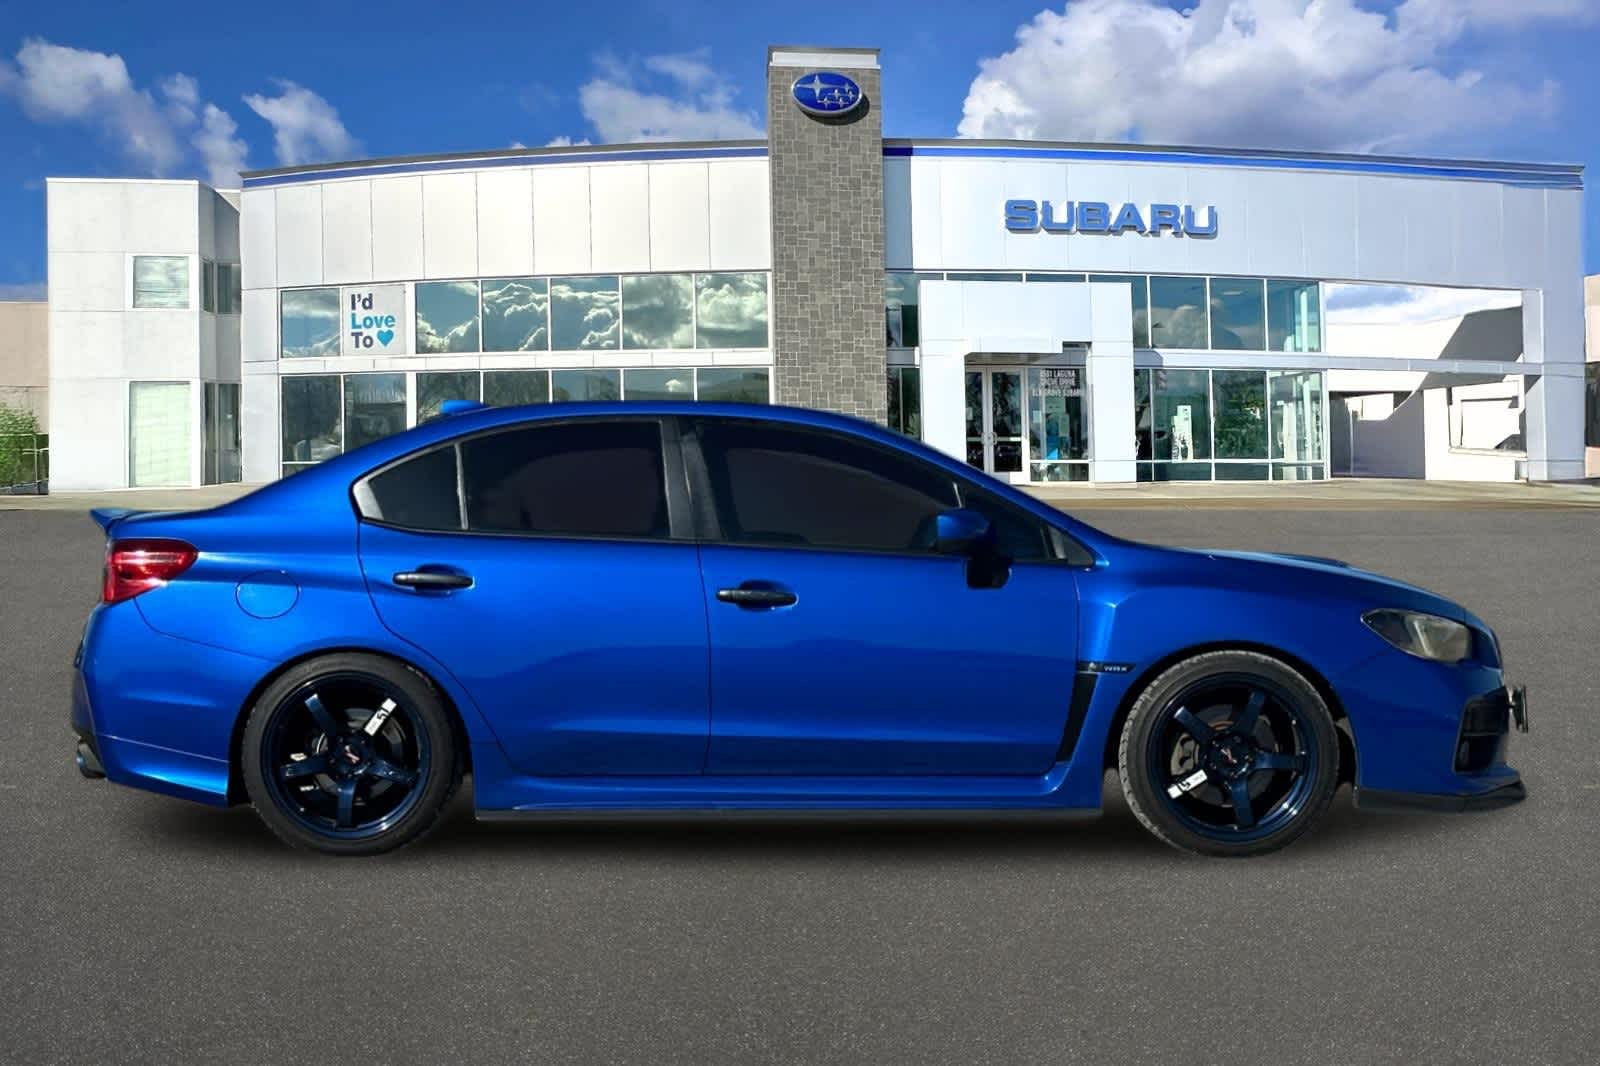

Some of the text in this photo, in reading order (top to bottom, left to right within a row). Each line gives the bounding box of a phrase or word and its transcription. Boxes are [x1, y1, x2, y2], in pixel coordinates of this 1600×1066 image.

[1005, 199, 1218, 238] SUBARU
[351, 293, 373, 310] I'd
[351, 313, 396, 329] Love
[351, 331, 374, 348] To
